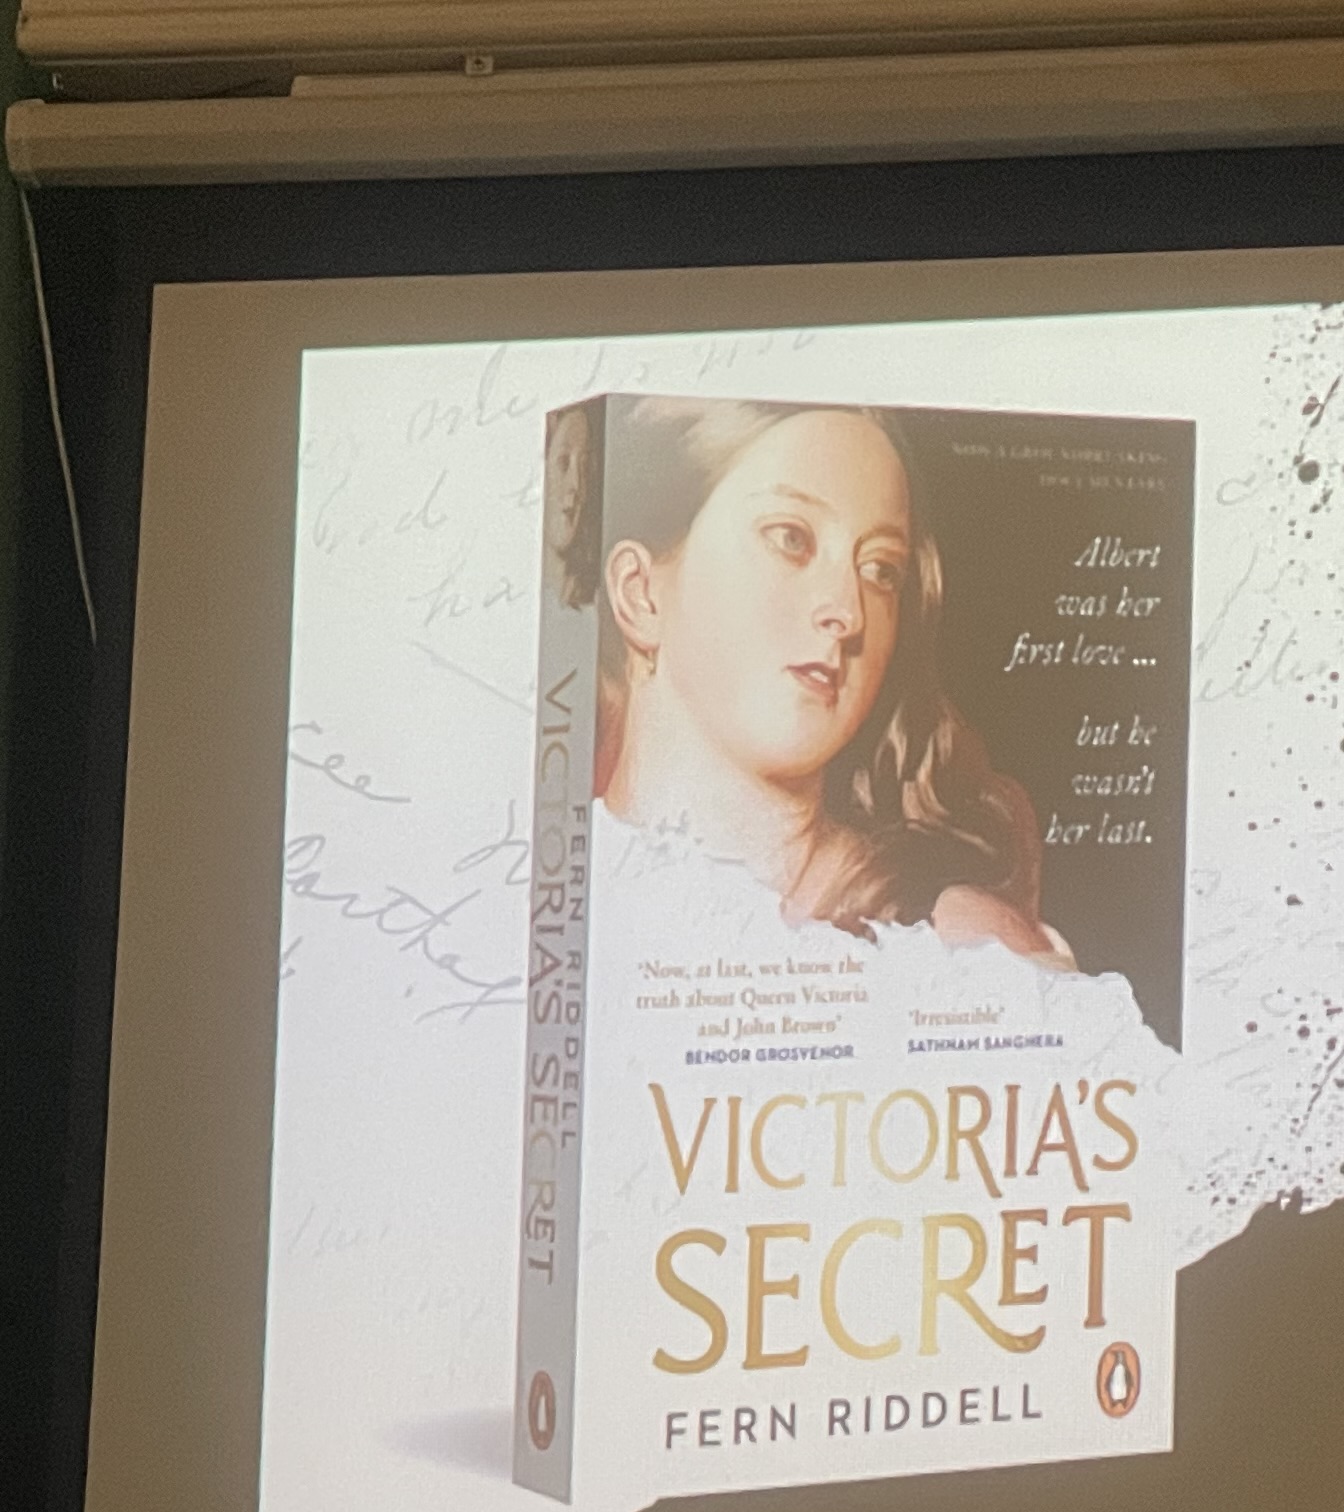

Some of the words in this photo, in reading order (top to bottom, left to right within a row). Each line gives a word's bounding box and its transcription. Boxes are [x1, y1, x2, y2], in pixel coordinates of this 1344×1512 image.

[1074, 536, 1161, 568] Albert
[1055, 594, 1107, 619] was
[1116, 586, 1161, 618] her
[1004, 632, 1064, 672] first
[1072, 633, 1126, 666] love
[1076, 715, 1119, 746] but
[1128, 715, 1157, 746] he
[1044, 812, 1090, 844] her
[1097, 812, 1153, 844] last.
[568, 803, 587, 922] FERN
[759, 963, 780, 976] we
[787, 955, 832, 975] know
[839, 955, 864, 975] the
[636, 991, 681, 1010] truth
[685, 989, 735, 1009] about
[740, 987, 796, 1010] Queen
[800, 986, 868, 1005] Victoria
[698, 1018, 730, 1037] and
[734, 1017, 776, 1039] John
[907, 1036, 980, 1053] SATHNAM
[985, 1034, 1064, 1051] SANGHERA
[561, 948, 584, 1149] RIDDELL
[685, 1049, 751, 1065] BENDOR
[756, 1045, 855, 1062] GROSVENOR
[648, 1079, 1139, 1198] VICTORIA'S
[526, 1052, 559, 1286] SECRET
[652, 1202, 1133, 1374] SECRET
[665, 1402, 797, 1450] FERN
[827, 1383, 1043, 1436] RIDDELL
